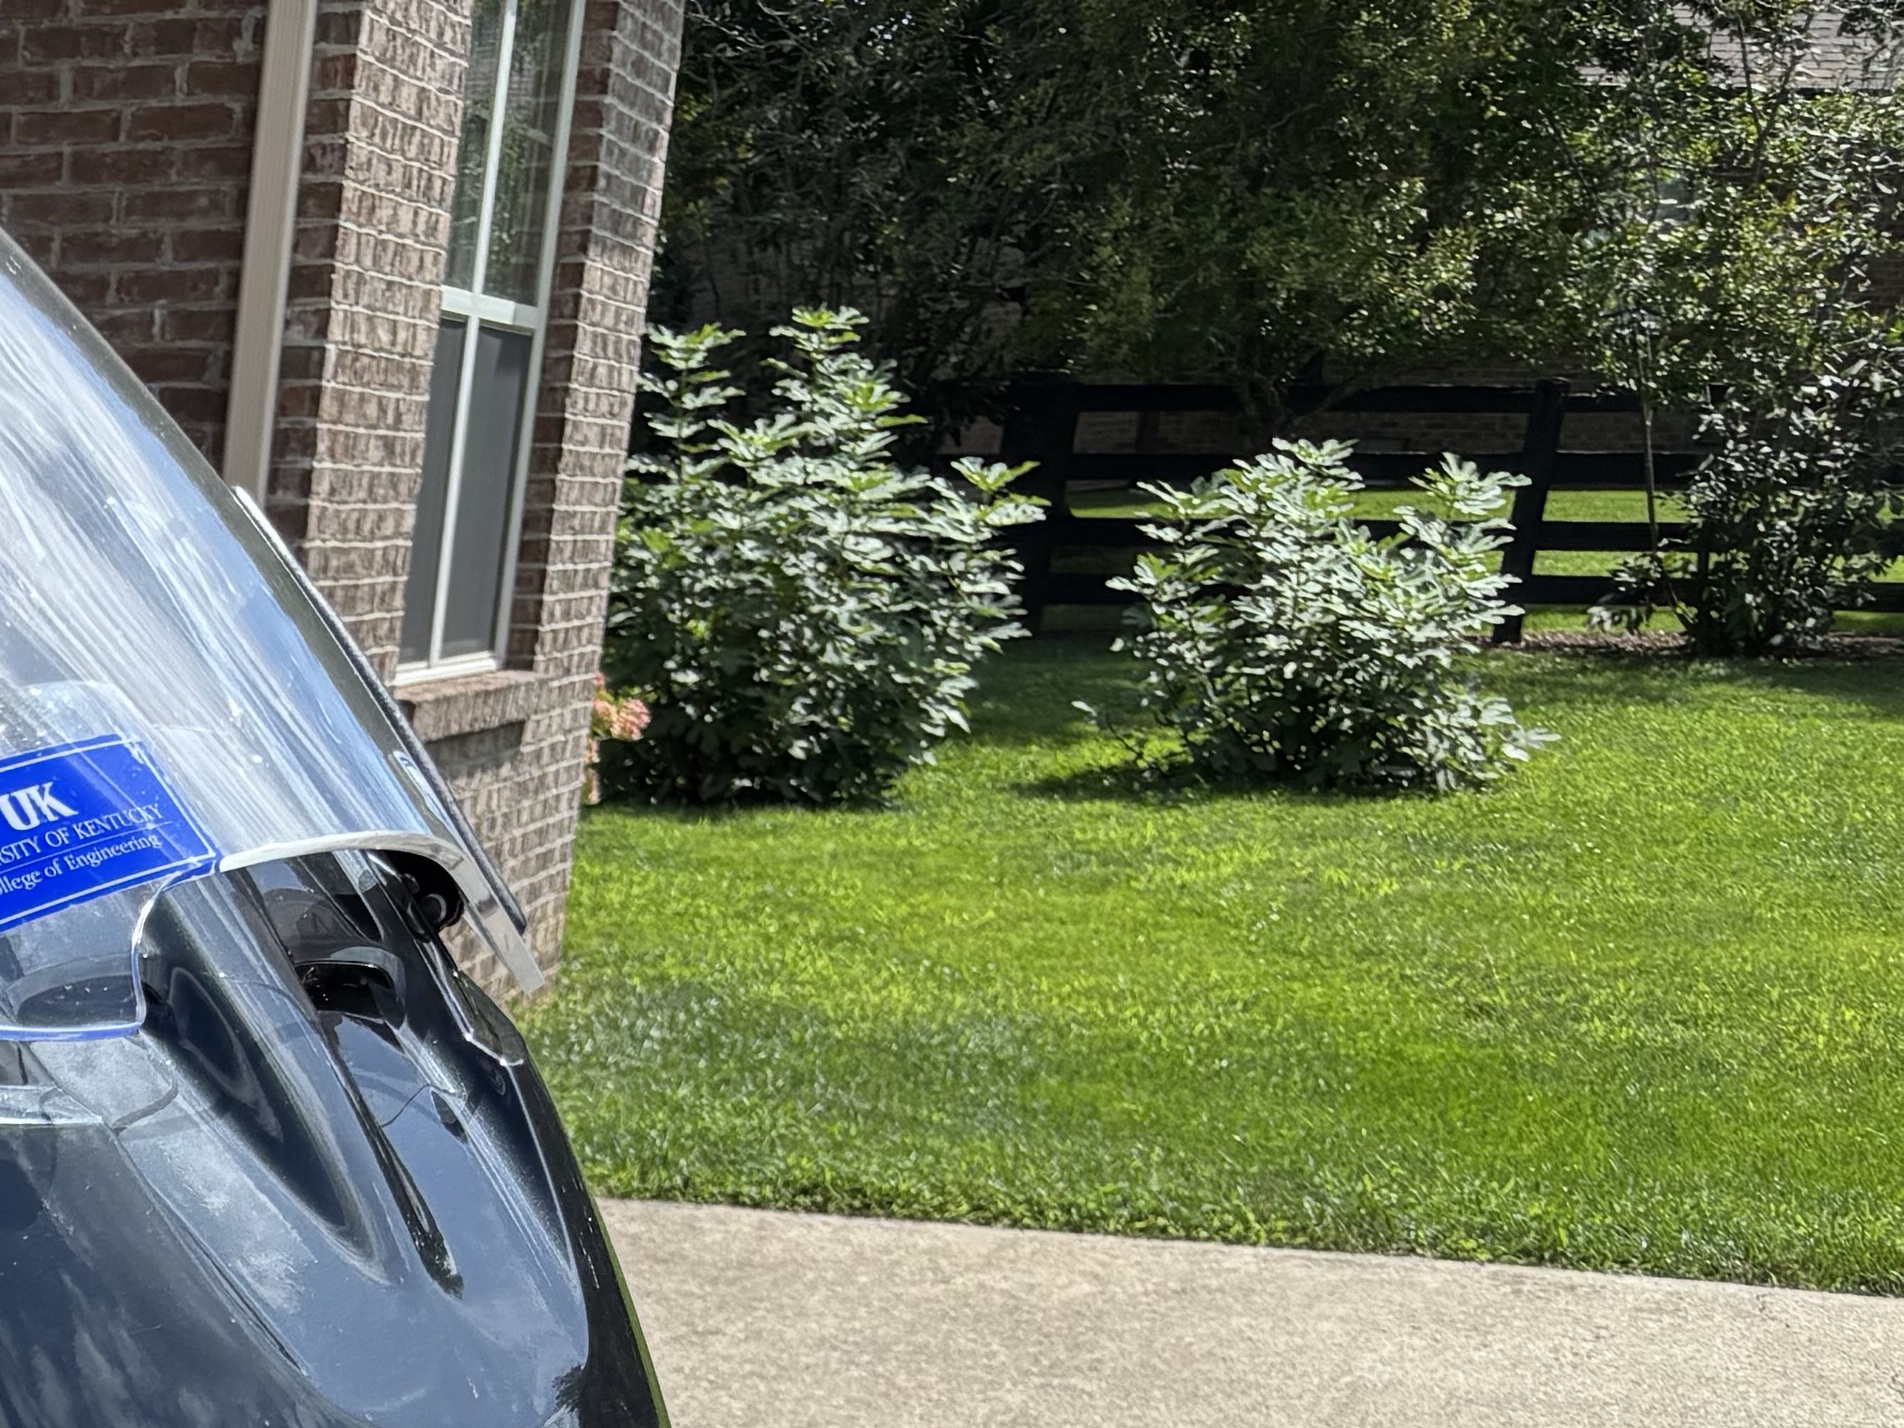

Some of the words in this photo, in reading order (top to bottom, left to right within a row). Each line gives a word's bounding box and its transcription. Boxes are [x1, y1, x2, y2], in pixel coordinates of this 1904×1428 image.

[44, 827, 69, 849] OF
[72, 803, 164, 840] KENTUCKY
[44, 857, 62, 879] of
[65, 833, 163, 873] Engineering
